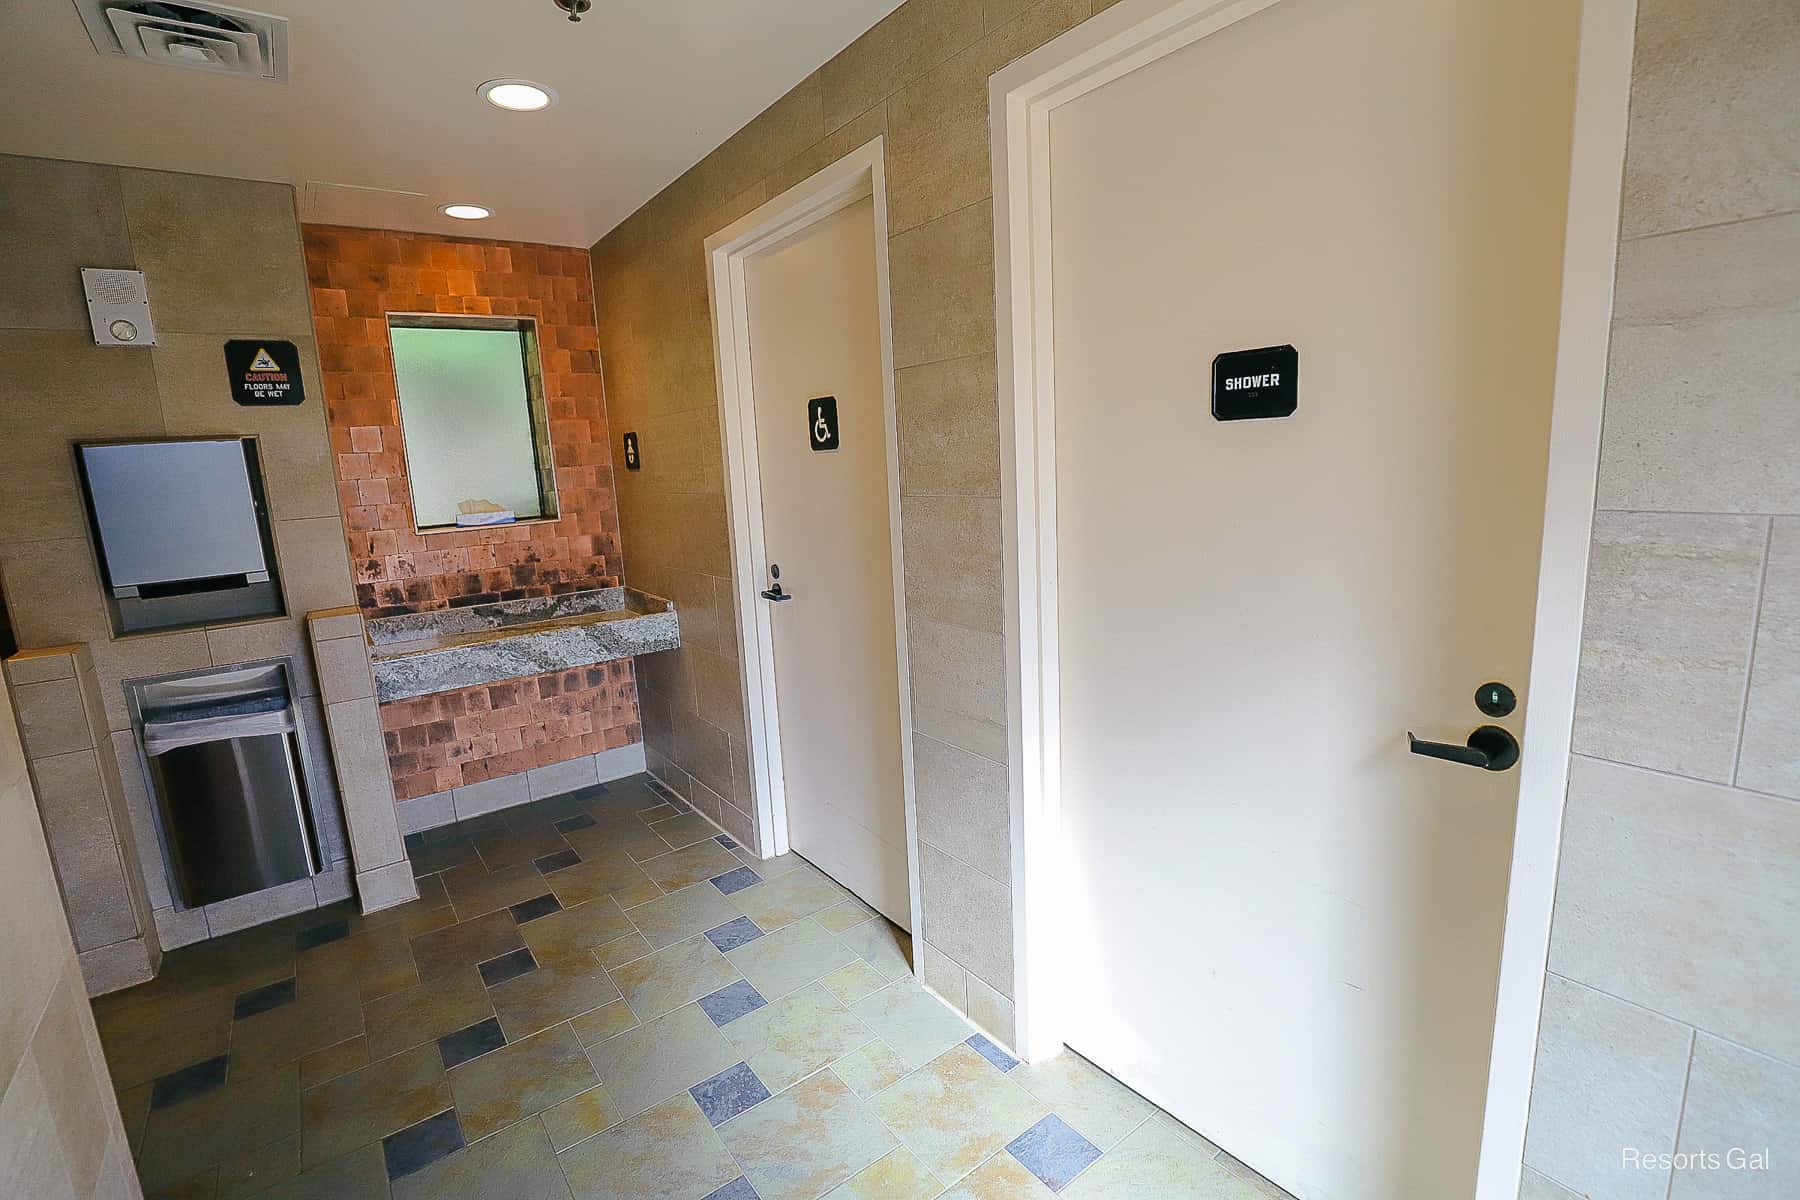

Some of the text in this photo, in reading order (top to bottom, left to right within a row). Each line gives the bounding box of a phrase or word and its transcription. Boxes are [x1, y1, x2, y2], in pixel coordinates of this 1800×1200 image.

[245, 373, 288, 382] CAUTION
[1225, 373, 1280, 391] SHOWER
[244, 383, 291, 391] FLOORS MAY
[254, 390, 283, 398] BE WET
